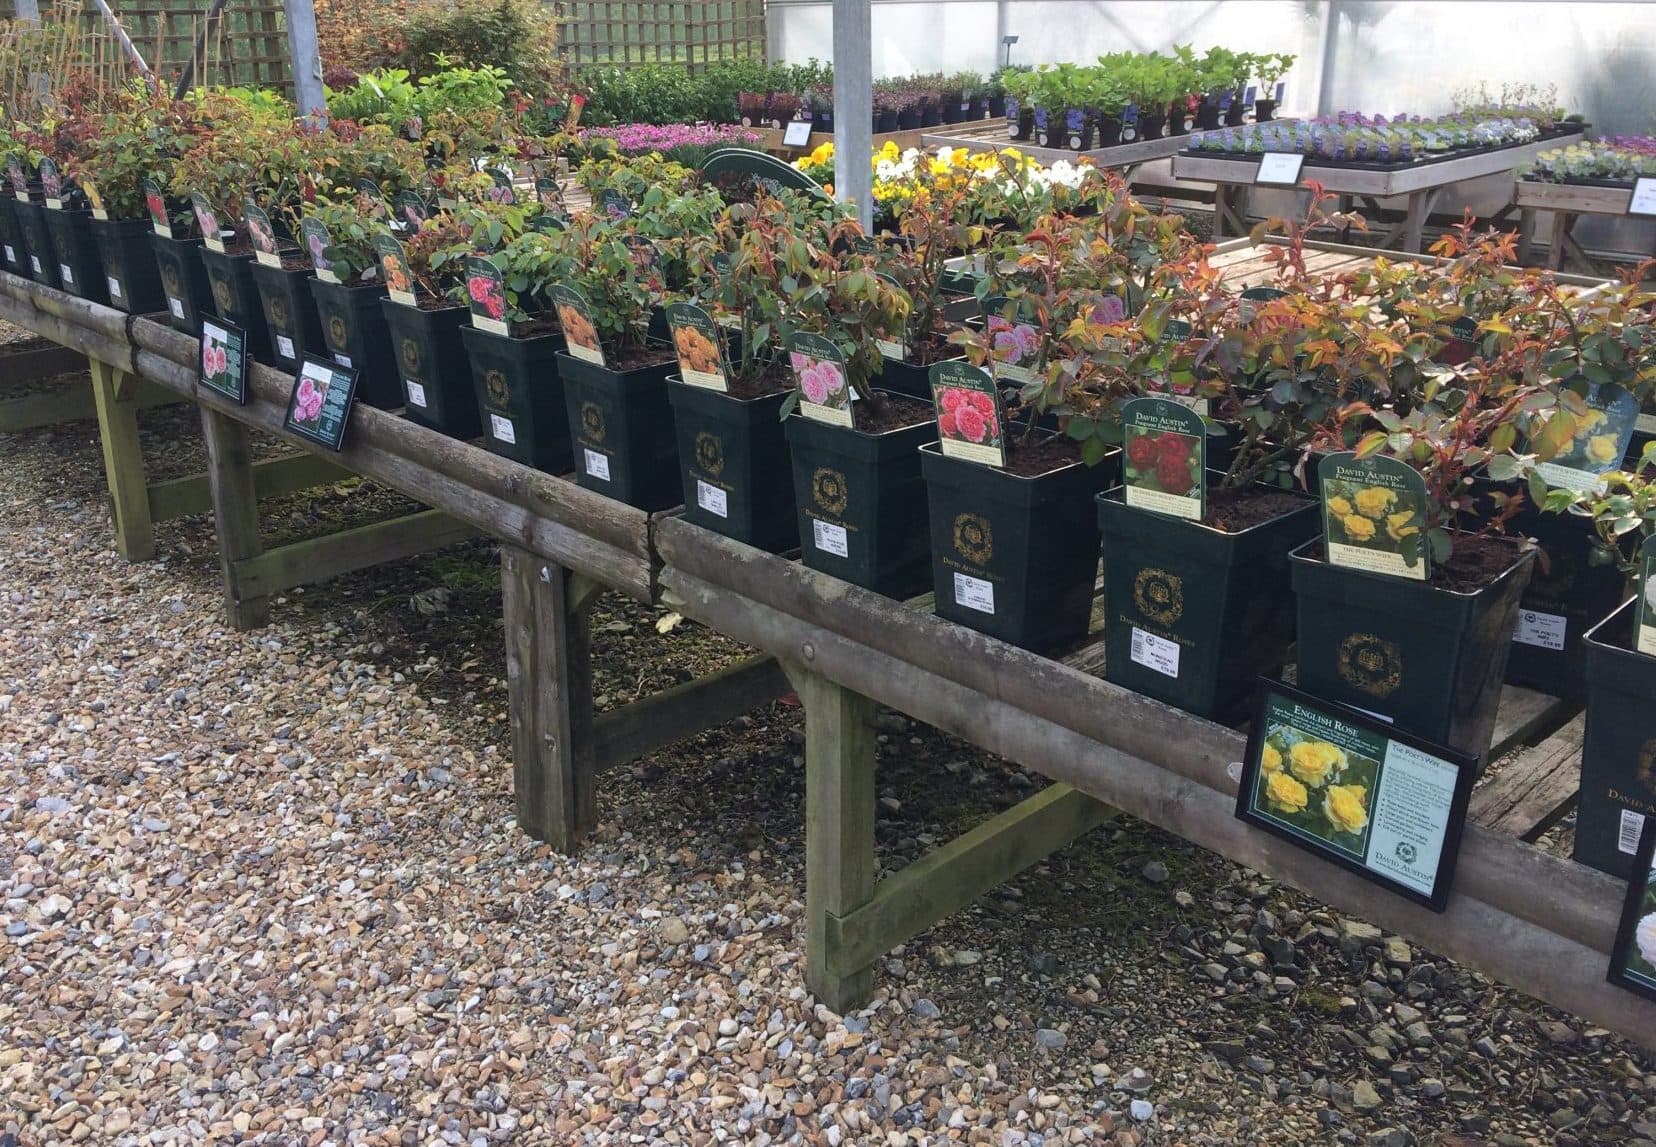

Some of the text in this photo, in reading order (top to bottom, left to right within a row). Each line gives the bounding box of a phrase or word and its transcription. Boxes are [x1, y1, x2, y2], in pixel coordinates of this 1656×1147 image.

[1136, 412, 1187, 427] DAVID AUSTIN
[1336, 466, 1400, 482] DAVID AUSTIN
[1294, 705, 1333, 728] ENGLISH
[1333, 720, 1361, 738] ROSE
[1608, 788, 1643, 808] DAVID
